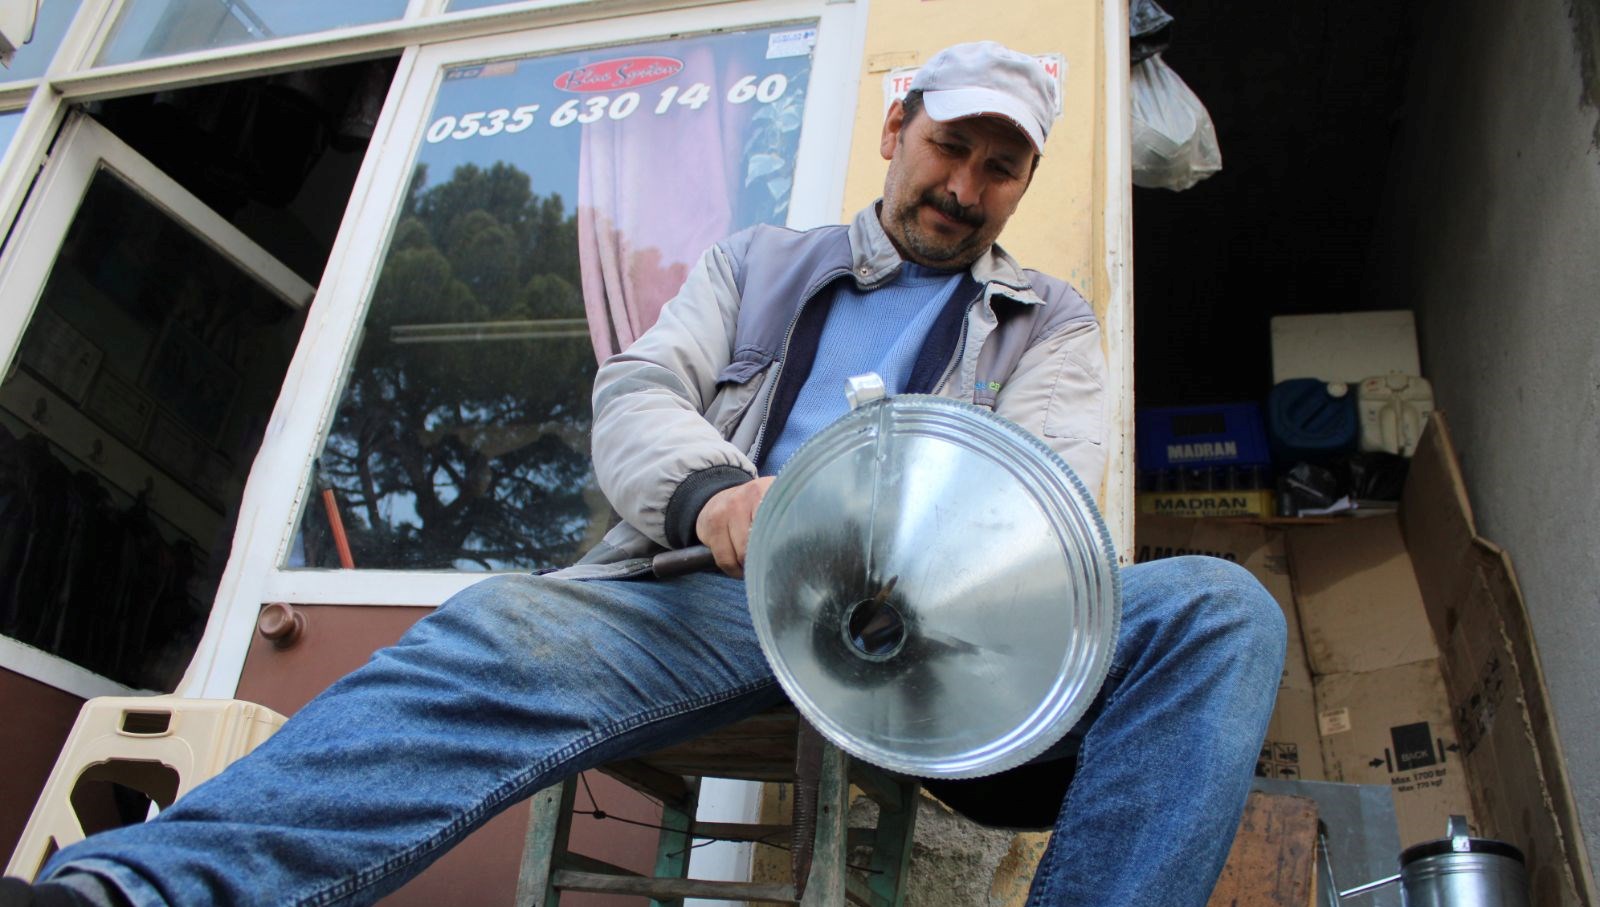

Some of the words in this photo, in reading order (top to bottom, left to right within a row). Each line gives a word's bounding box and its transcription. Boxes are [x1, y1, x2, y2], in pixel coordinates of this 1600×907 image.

[426, 104, 540, 143] 0535
[550, 92, 640, 127] 630
[655, 83, 711, 114] 14
[727, 73, 788, 104] 60
[1167, 441, 1238, 459] MADRAN
[1154, 497, 1248, 510] MADRAN
